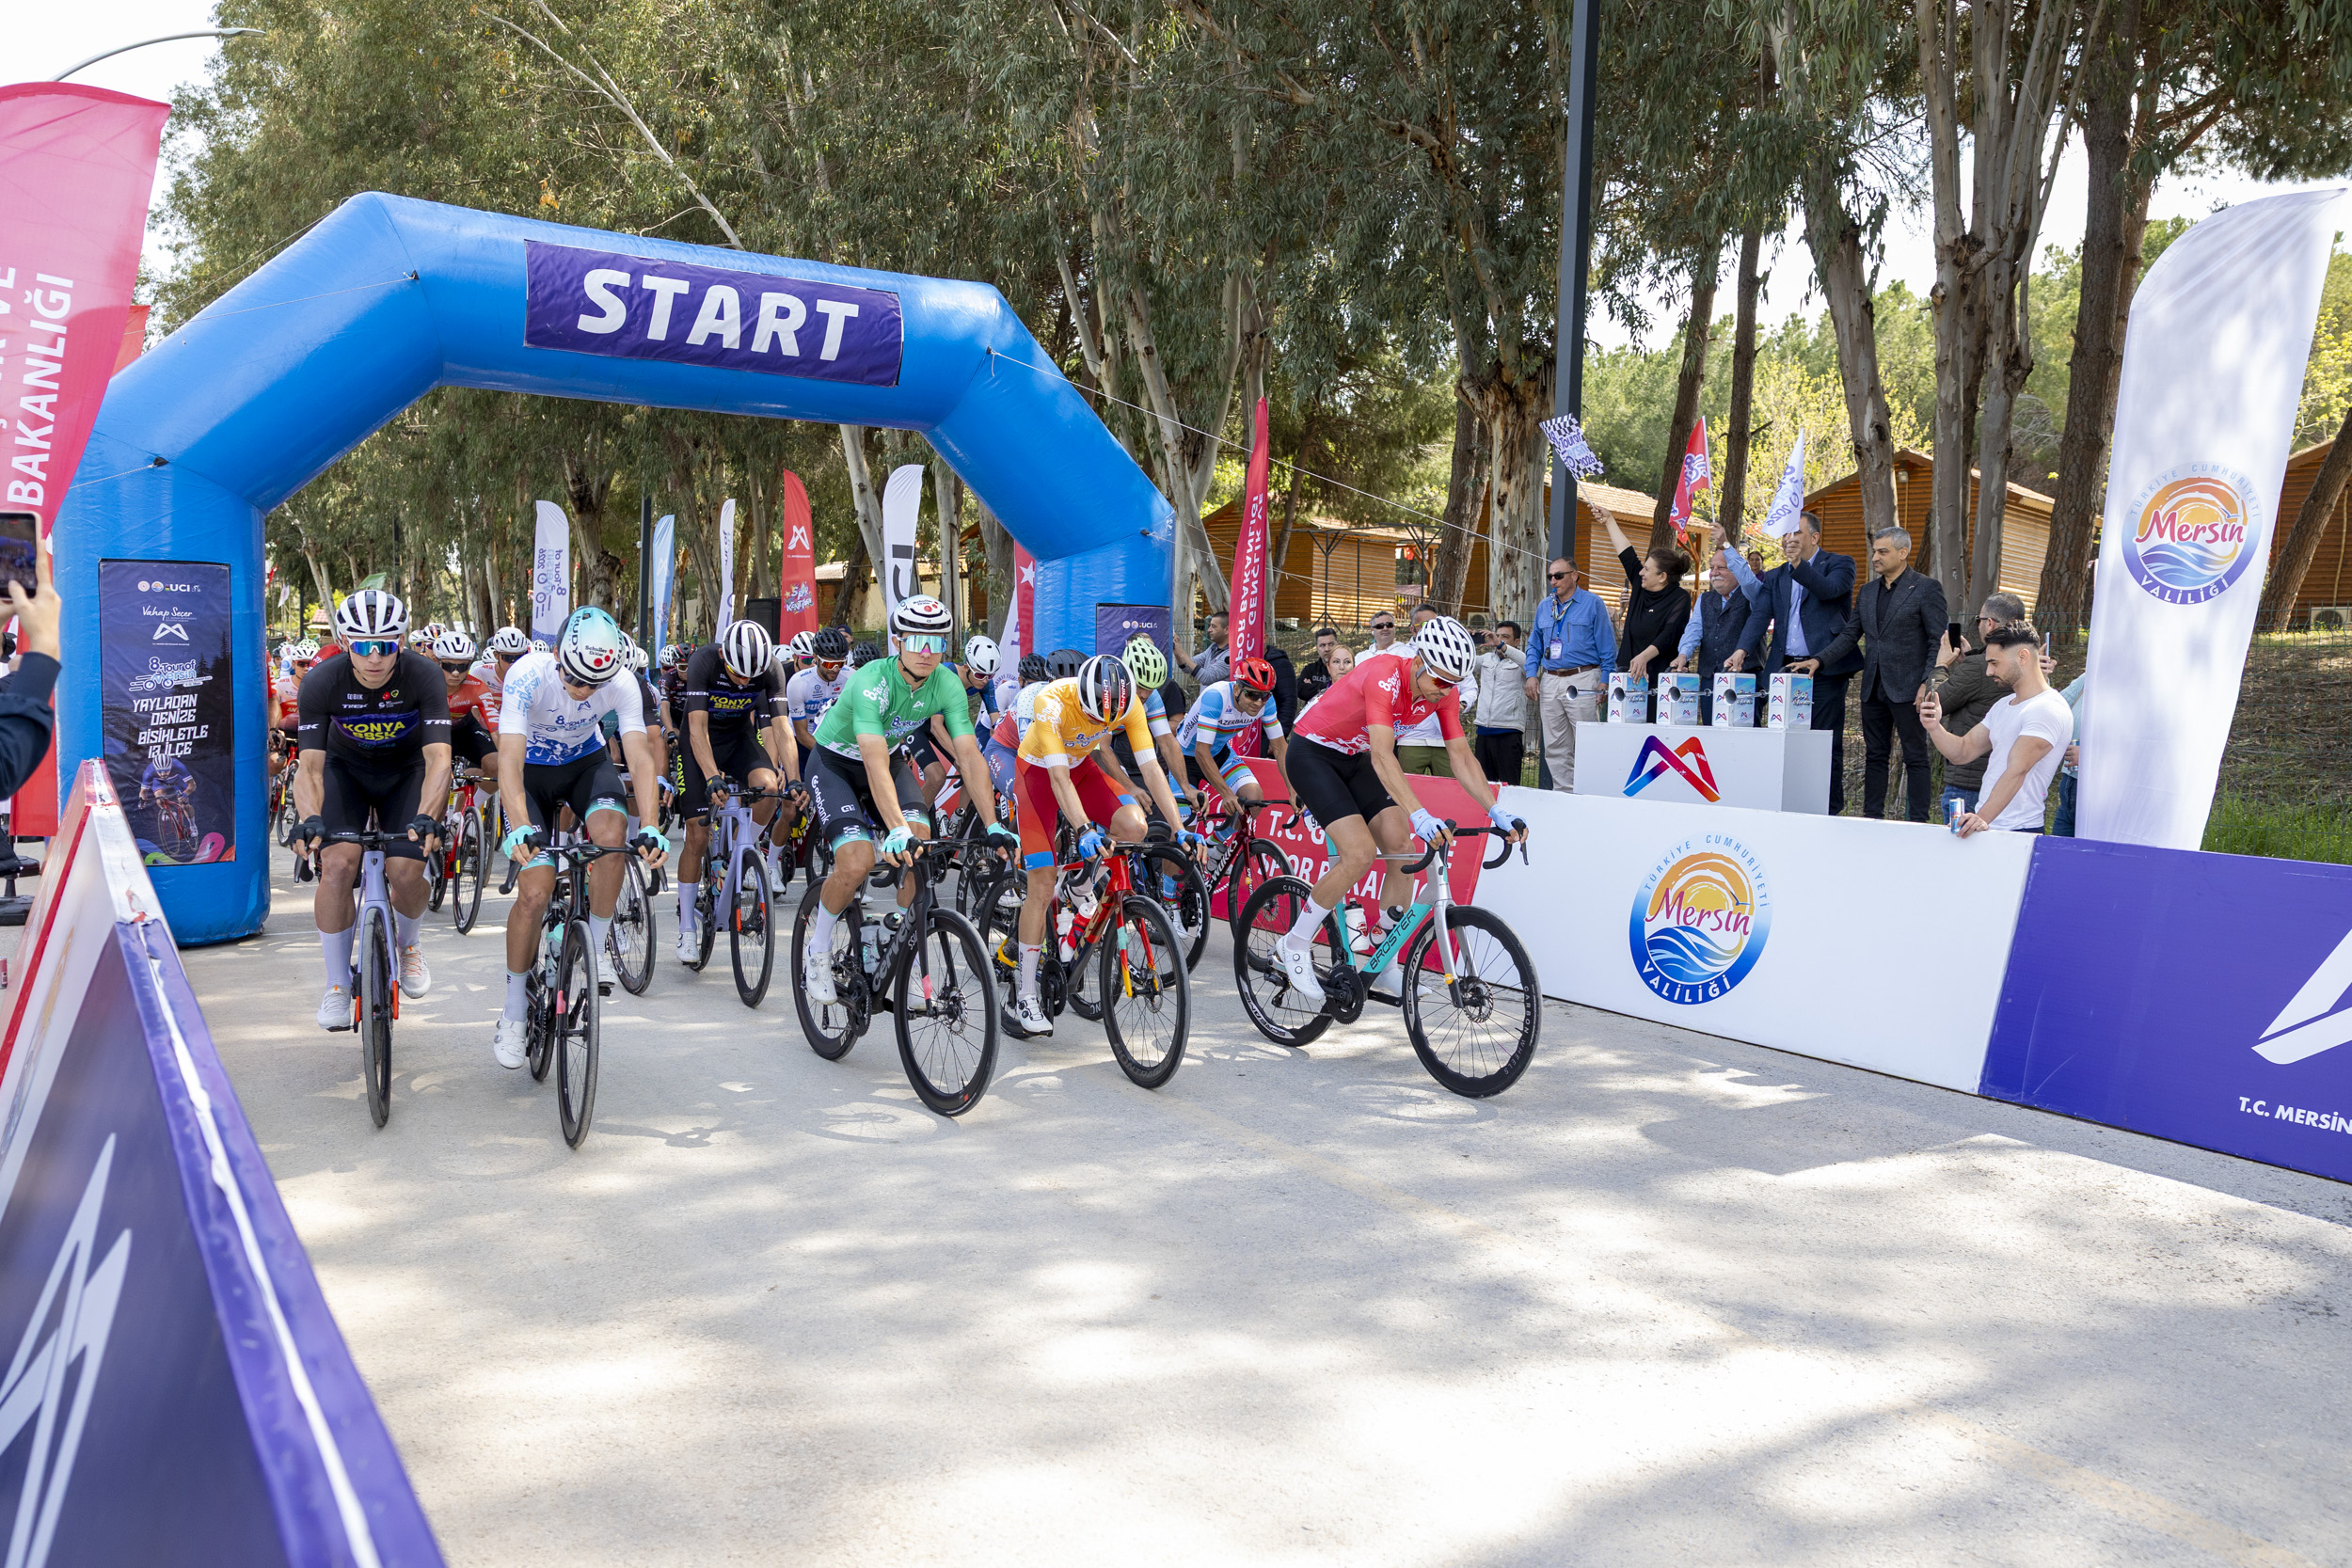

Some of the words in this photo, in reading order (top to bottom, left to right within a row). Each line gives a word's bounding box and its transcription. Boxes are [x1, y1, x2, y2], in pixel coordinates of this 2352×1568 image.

[577, 269, 859, 361] START
[7, 273, 73, 506] BAKANLIĞI
[2130, 469, 2178, 515] TÜRKİYE
[2191, 464, 2261, 517] CUMHURİYETİ
[2140, 574, 2230, 604] VALİLİĞİ
[572, 616, 580, 656] RUDY
[151, 669, 197, 684] Mersin
[184, 659, 196, 671] of
[133, 693, 199, 712] YAYLADAN
[151, 707, 197, 725] DENİZE
[709, 695, 753, 705] KONYA
[342, 721, 405, 733] KONYA
[165, 741, 193, 757] İLÇE
[676, 754, 686, 796] KONYA
[1645, 840, 1692, 891] TÜRKİYE
[1706, 834, 1770, 908] CUMHURİYETİ
[1370, 910, 1416, 971] BROSTER
[1643, 959, 1731, 1003] VALİLİĞİ
[1523, 985, 1532, 1034] CARBON
[1503, 1039, 1527, 1076] WHEELS
[2239, 1096, 2270, 1117] T.C.
[2274, 1104, 2352, 1135] MERSİN
